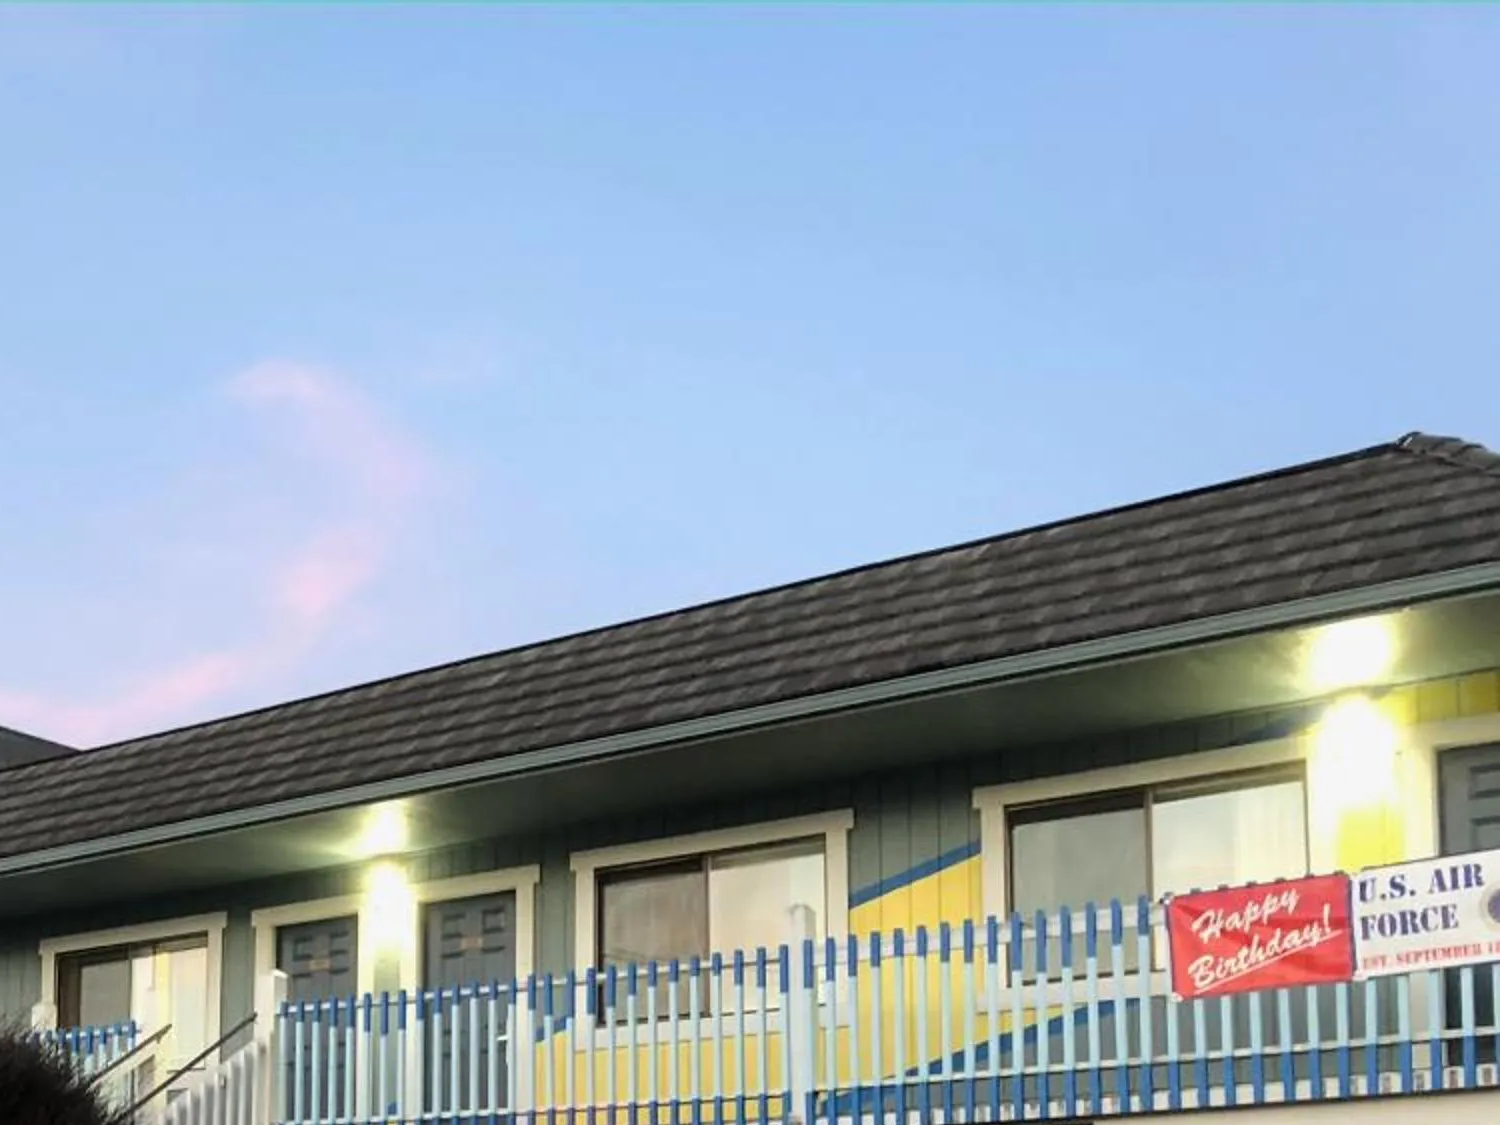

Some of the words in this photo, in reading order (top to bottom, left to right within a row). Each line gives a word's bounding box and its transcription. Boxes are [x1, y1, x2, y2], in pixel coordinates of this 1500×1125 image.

[1359, 873, 1416, 902] U.S.
[1428, 863, 1485, 894] AIR
[1191, 888, 1299, 944] Happy
[1361, 903, 1459, 941] FORCE
[1187, 903, 1332, 988] Birthday!
[1396, 942, 1482, 964] SEPTEMBER
